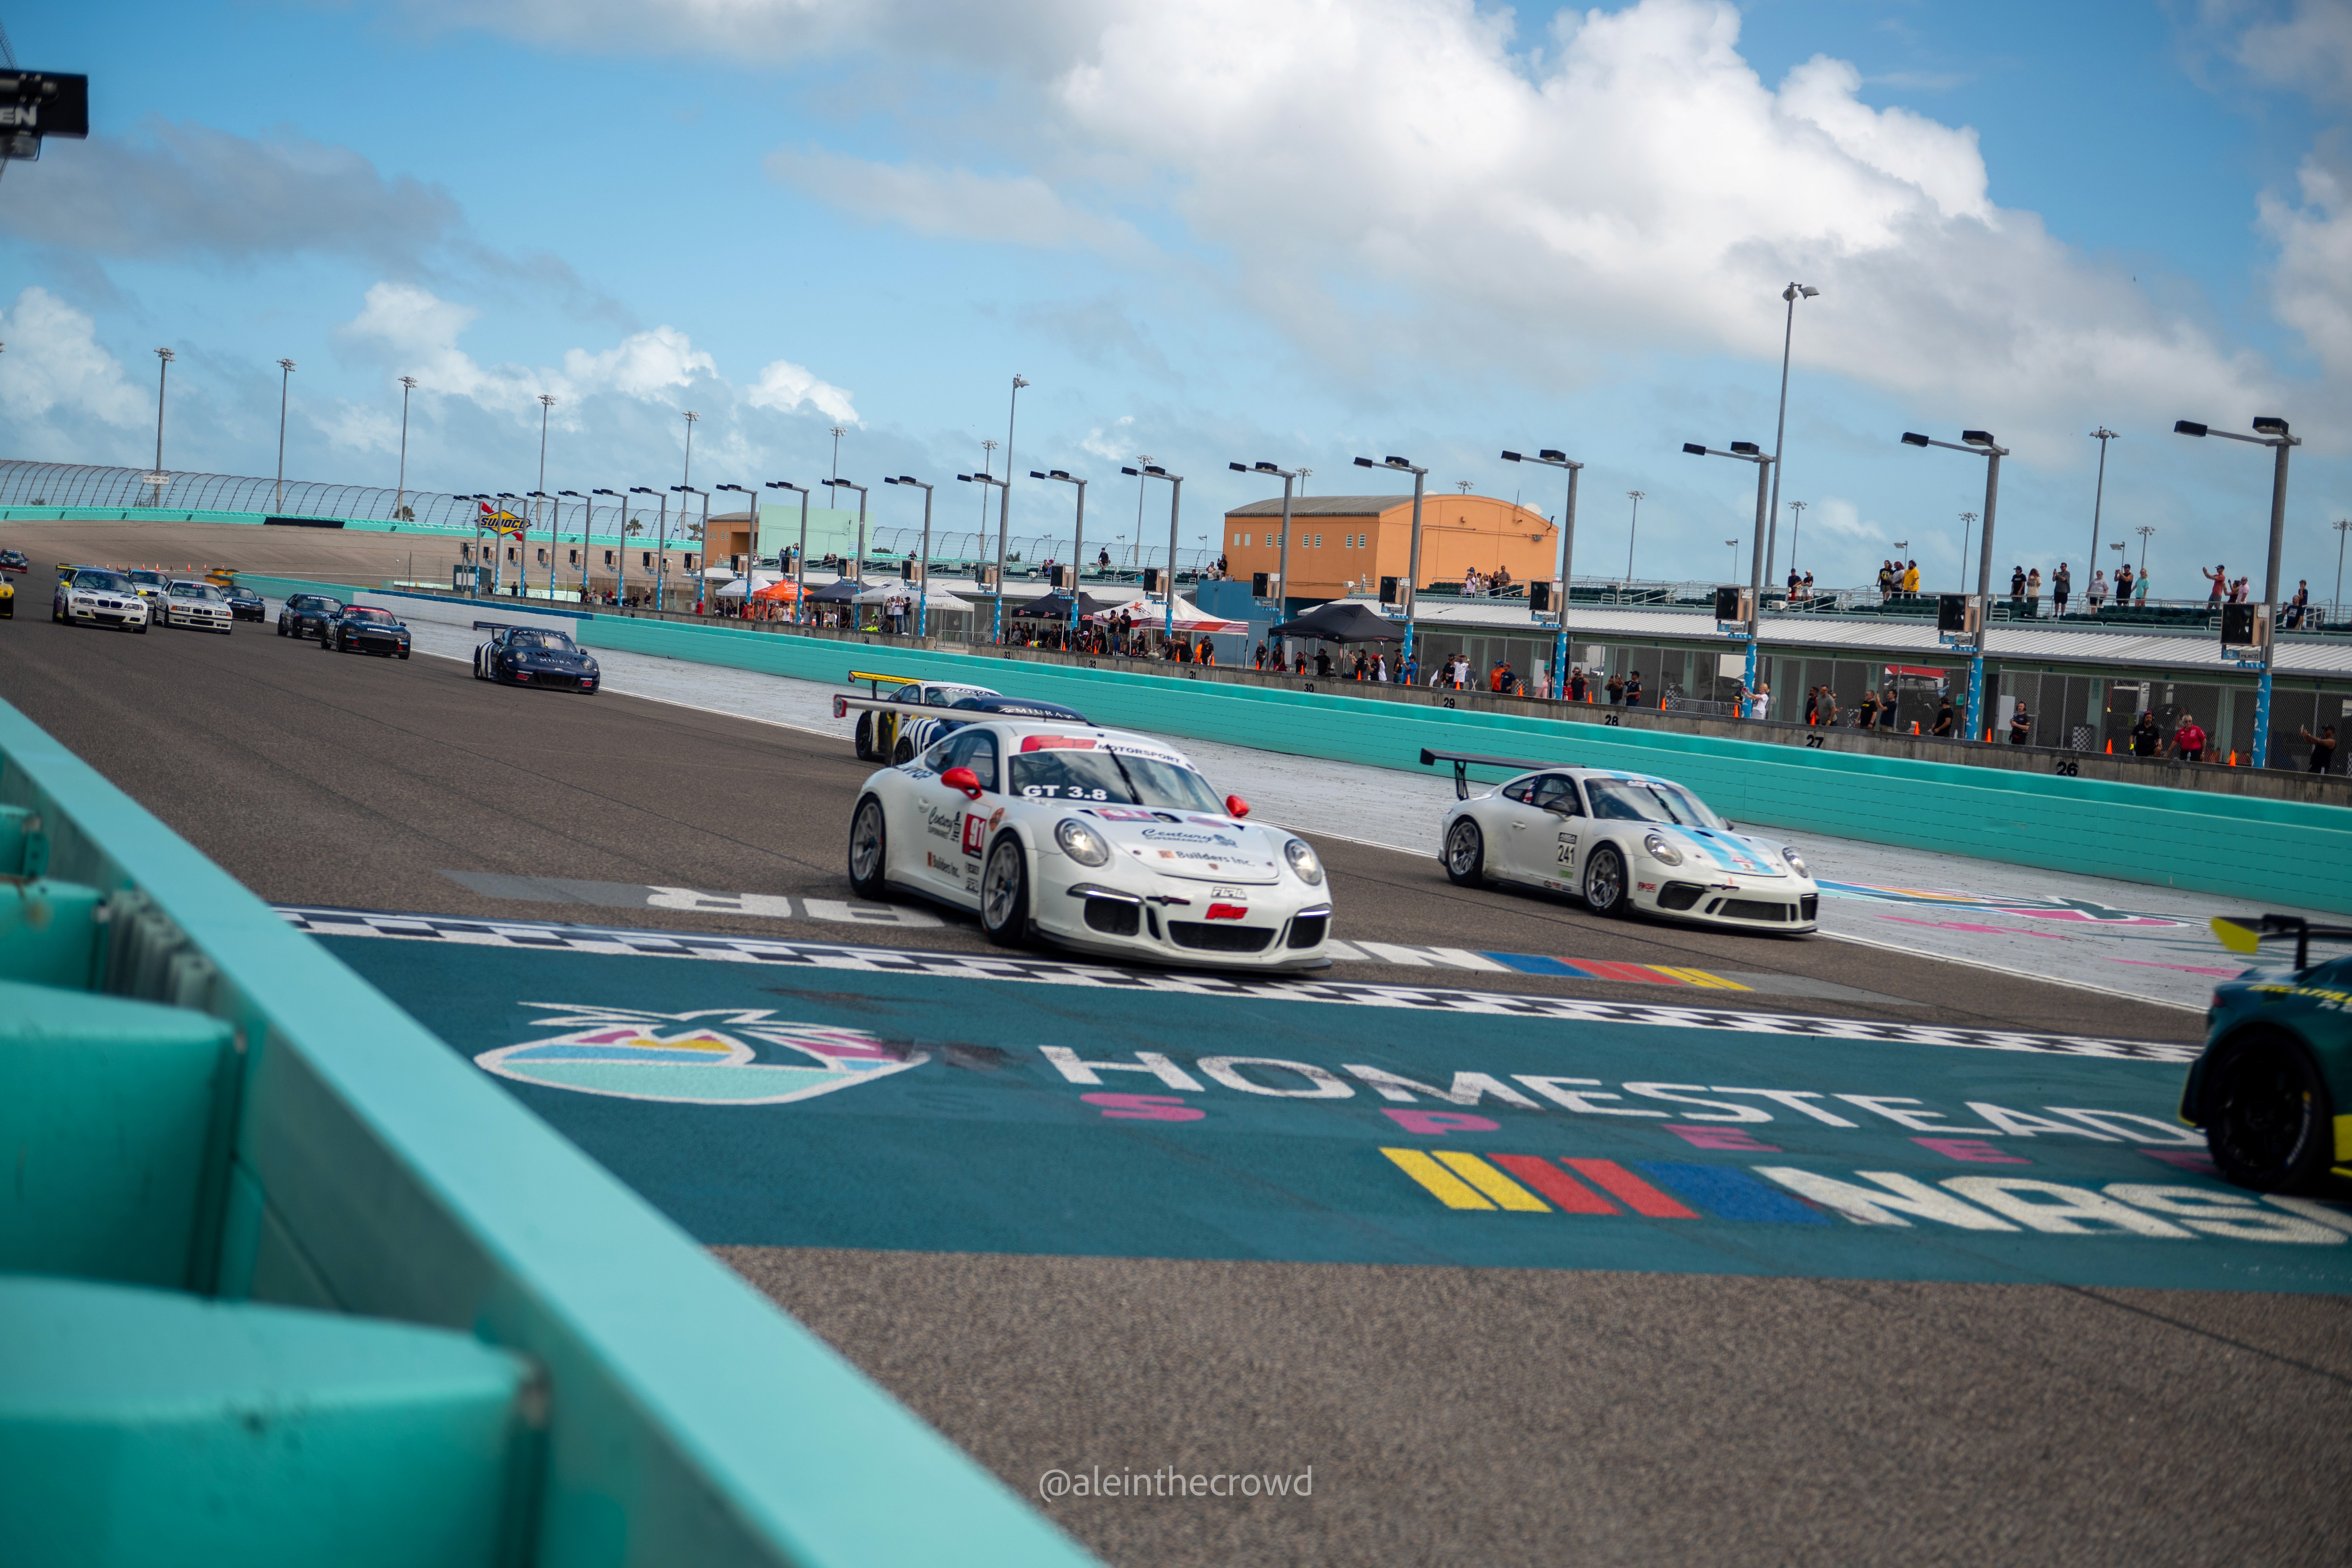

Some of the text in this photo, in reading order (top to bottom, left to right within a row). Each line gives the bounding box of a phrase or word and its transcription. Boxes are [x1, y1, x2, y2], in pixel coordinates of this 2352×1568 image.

[864, 636, 870, 644] 34
[1089, 660, 1097, 668] 32
[1189, 670, 1196, 680] 31
[1304, 683, 1314, 693] 30
[1444, 697, 1455, 709] 29
[1015, 708, 1064, 718] MIURA
[1605, 714, 1619, 726] 28
[1806, 734, 1824, 749] 27
[1098, 744, 1181, 764] MOTORSPORT
[2056, 761, 2078, 777] 26
[1022, 785, 1108, 801] GT 3.8
[969, 817, 985, 848] 91
[1142, 828, 1216, 843] Century
[1175, 851, 1256, 867] Builders Inc.
[1557, 844, 1575, 864] 241
[1038, 1044, 2210, 1145] HOMESTEAD
